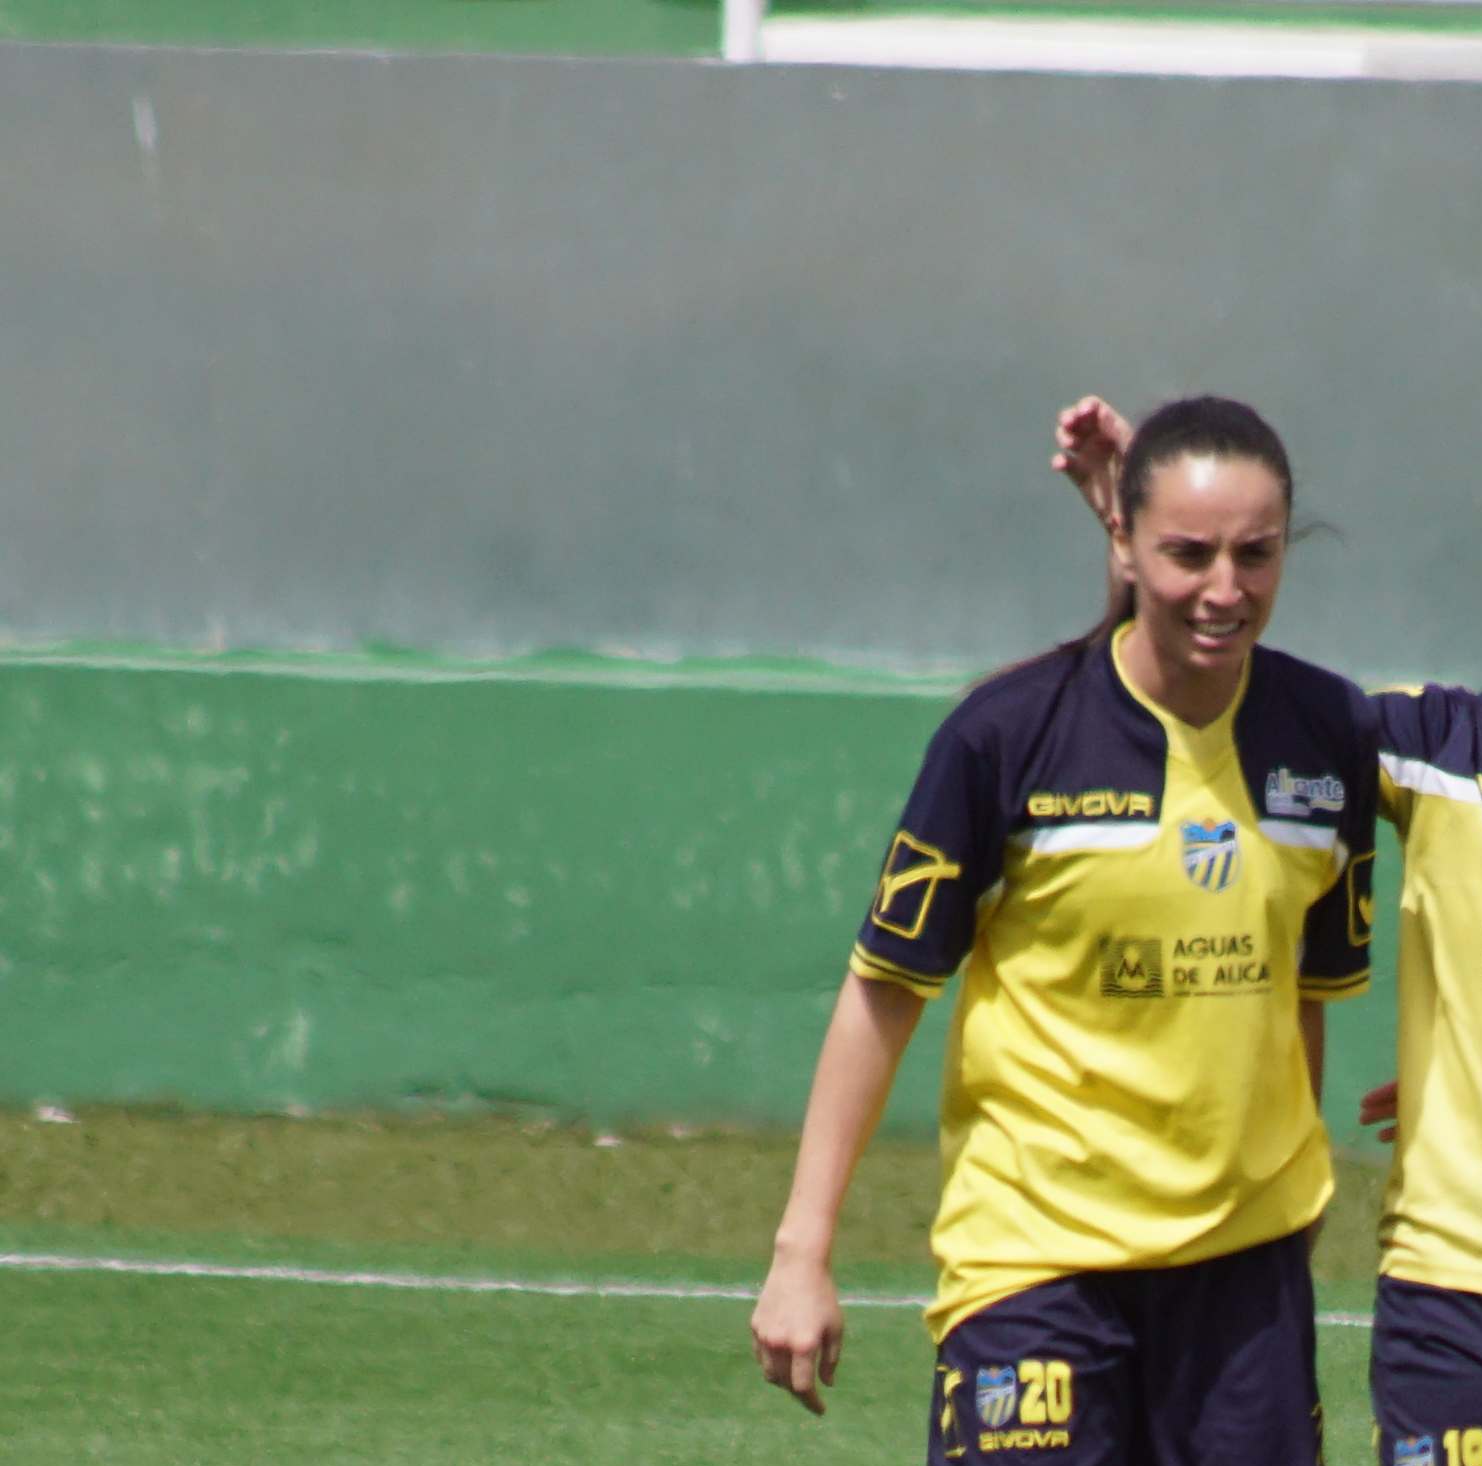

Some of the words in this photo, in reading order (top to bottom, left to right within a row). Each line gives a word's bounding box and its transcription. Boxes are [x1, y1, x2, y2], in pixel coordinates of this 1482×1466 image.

[1028, 790, 1152, 817] GIVOVA
[1174, 935, 1254, 958] AGUAS
[1173, 966, 1199, 985] DE
[1018, 1359, 1072, 1424] 20
